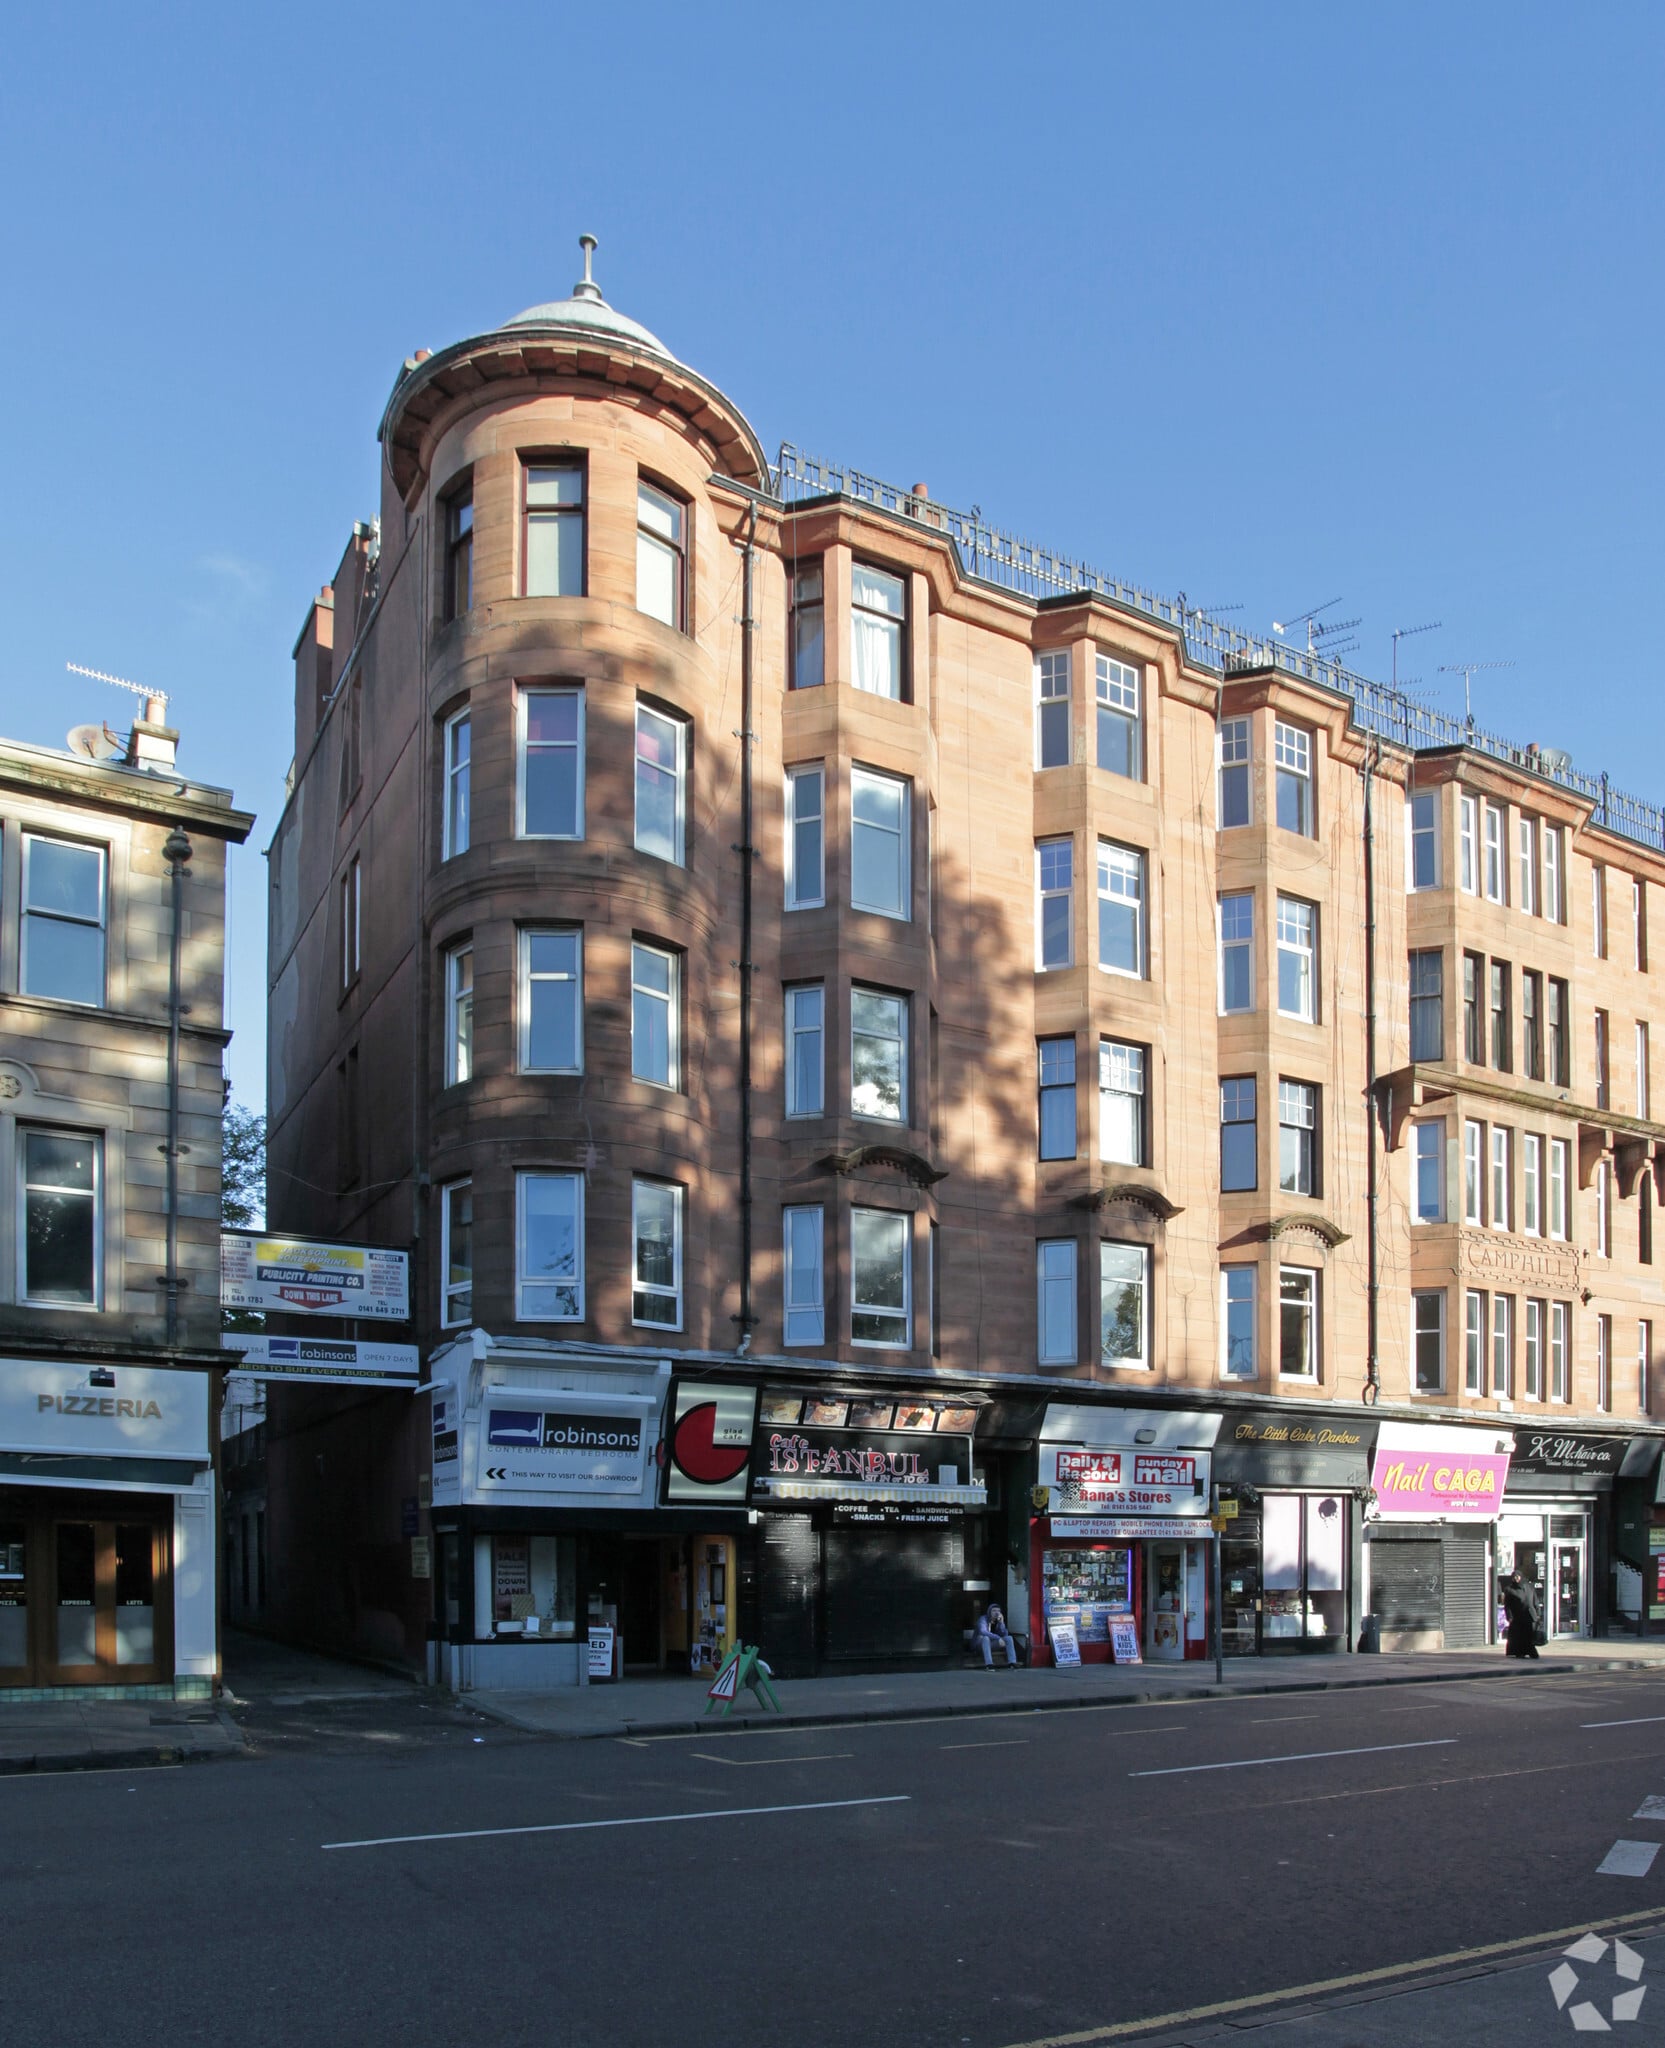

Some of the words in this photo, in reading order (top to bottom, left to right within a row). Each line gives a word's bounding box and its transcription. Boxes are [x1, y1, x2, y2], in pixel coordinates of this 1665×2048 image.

[1468, 1243, 1569, 1277] CAMPHILL
[262, 1269, 305, 1281] PUBLICITY
[306, 1273, 344, 1285] PRINTING
[346, 1277, 360, 1287] CO.
[284, 1289, 304, 1299] DOWN
[306, 1291, 321, 1301] THIS
[322, 1293, 338, 1303] LANE
[301, 1345, 356, 1361] robinsons
[364, 1353, 386, 1362] OPEN
[238, 1363, 267, 1371] BEDS
[285, 1366, 308, 1374] SUIT
[310, 1367, 344, 1375] EVERY
[345, 1369, 386, 1377] BUDGET
[38, 1394, 162, 1419] PIZZERIA
[546, 1426, 639, 1447] robinsons
[770, 1433, 809, 1449] Cafe
[1235, 1424, 1257, 1439] The
[1258, 1425, 1289, 1441] Little
[1289, 1427, 1316, 1442] Cake
[1317, 1428, 1360, 1445] Parlour
[487, 1446, 575, 1456] CONTEMPORARY
[581, 1451, 638, 1459] BEDROOMS
[770, 1448, 930, 1478] ISTANBUL
[1059, 1454, 1100, 1471] Daily
[1138, 1459, 1184, 1469] sunday
[595, 1474, 638, 1482] SHOWROOM
[864, 1474, 878, 1483] SIT
[917, 1476, 930, 1484] GO
[1059, 1468, 1118, 1481] Record
[1136, 1462, 1193, 1484] mail
[1382, 1462, 1430, 1494] Nail
[1433, 1467, 1495, 1492] CAGA
[1080, 1489, 1126, 1502] Rana's
[1132, 1491, 1172, 1504] Stores
